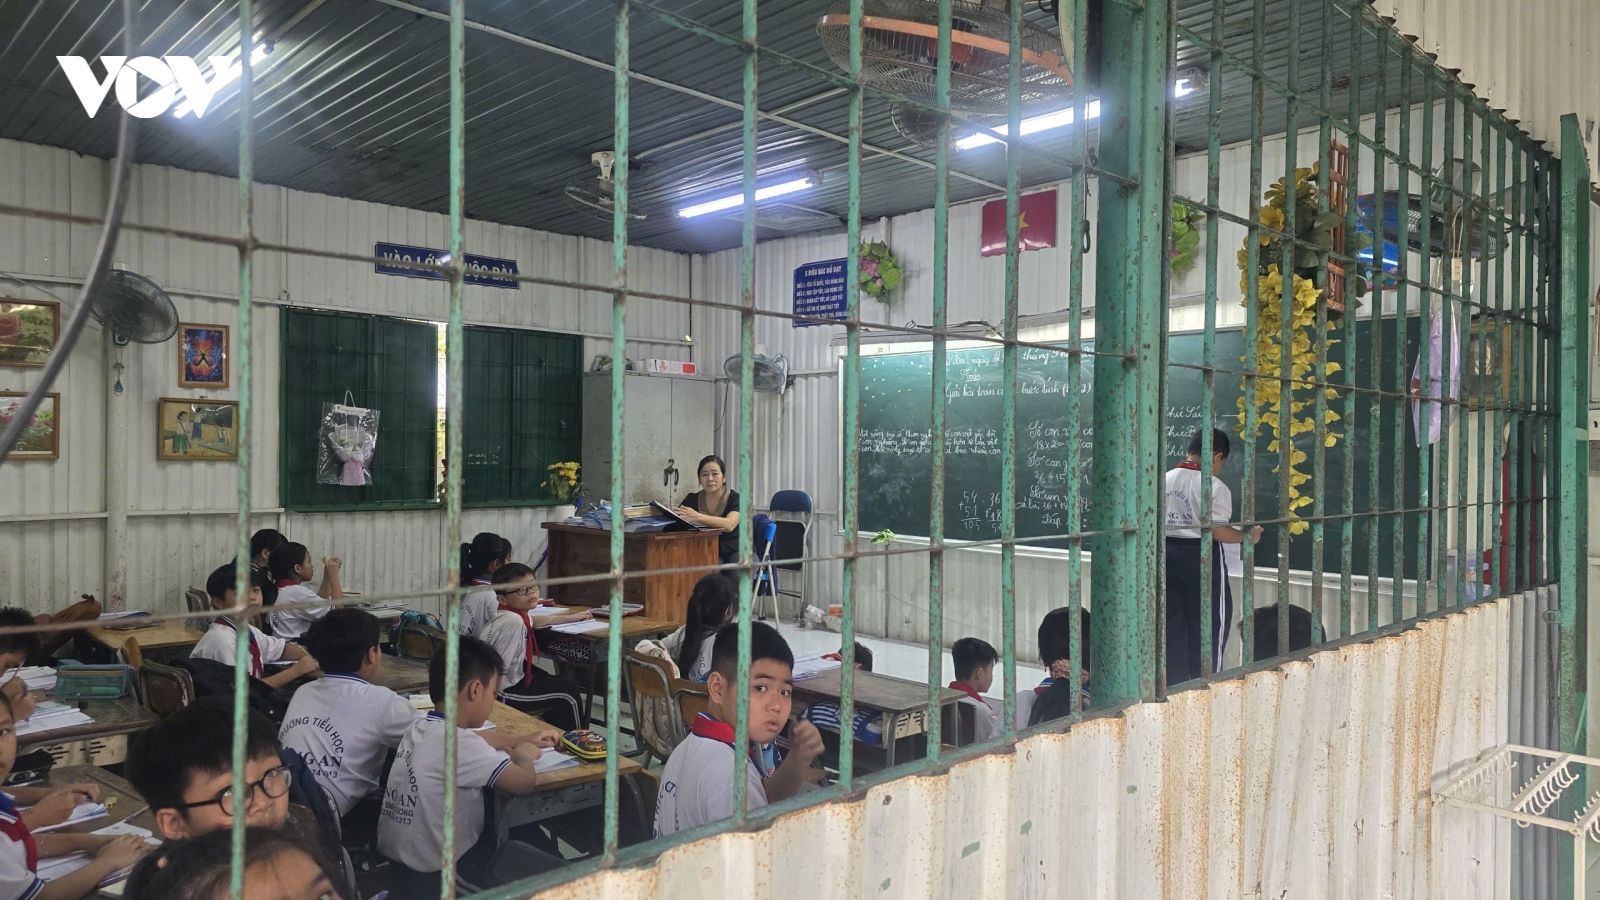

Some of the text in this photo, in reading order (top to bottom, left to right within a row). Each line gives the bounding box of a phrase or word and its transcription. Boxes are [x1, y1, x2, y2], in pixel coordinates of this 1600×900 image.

[383, 249, 412, 270] VÀO
[808, 267, 817, 277] ĐIỀU
[818, 267, 826, 275] BÁC
[826, 264, 833, 274] HỒ
[833, 265, 842, 274] DẠY
[1022, 348, 1049, 365] tháng
[963, 383, 974, 397] bài
[977, 383, 995, 397] toán
[1020, 380, 1040, 394] bước
[280, 716, 344, 754] RƯỜNG TIỂU HỌC
[318, 754, 343, 768] AN
[407, 767, 419, 793] HỌC
